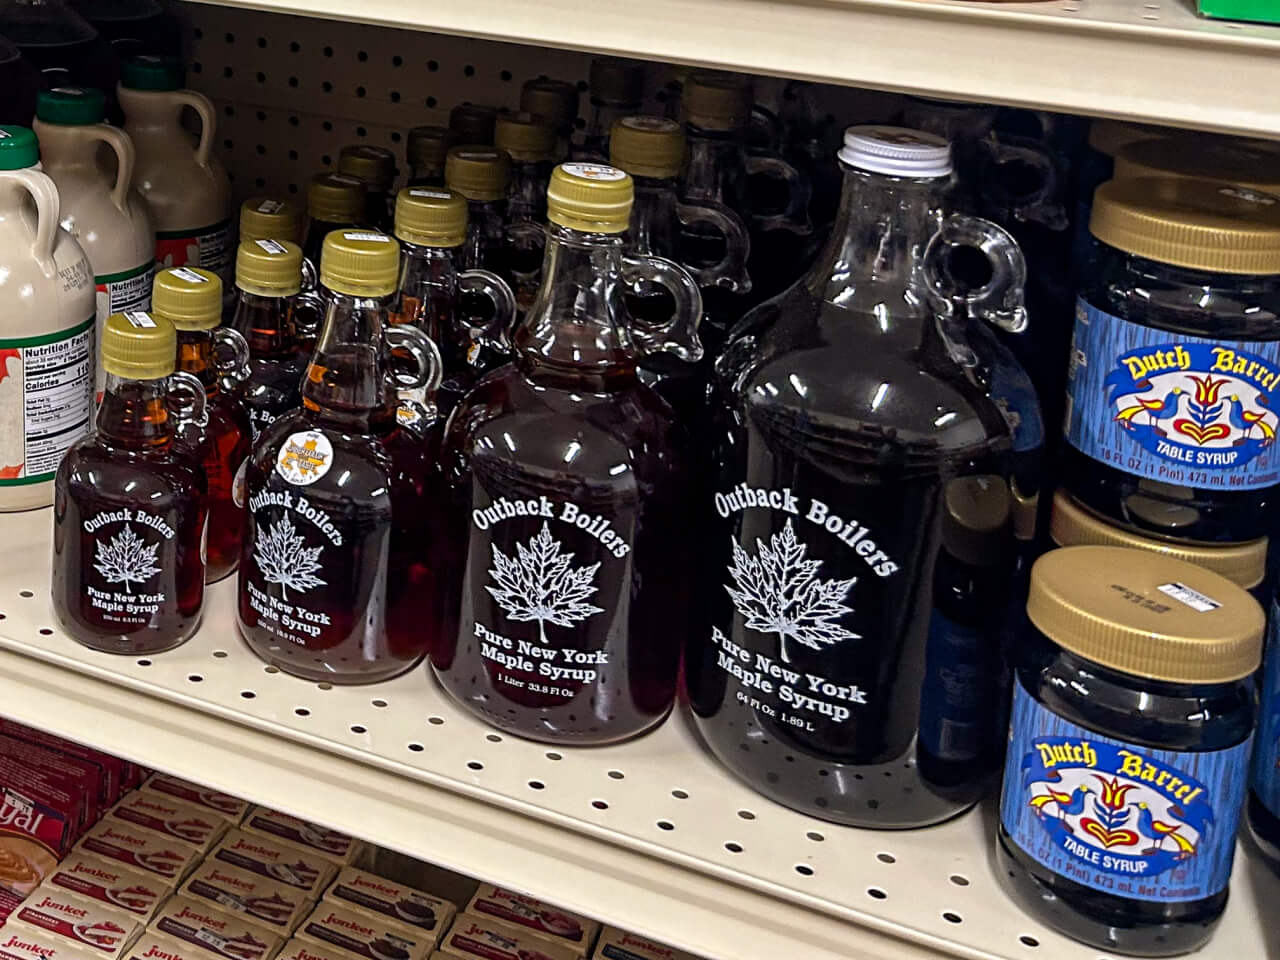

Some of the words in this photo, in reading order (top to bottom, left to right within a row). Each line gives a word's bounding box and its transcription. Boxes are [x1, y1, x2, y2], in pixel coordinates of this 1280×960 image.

[25, 342, 69, 358] Nutrition
[1122, 346, 1191, 380] Dutch
[1210, 347, 1280, 392] Barrel
[25, 378, 60, 390] Calories
[1156, 441, 1193, 462] TABLE
[1197, 451, 1238, 465] SYRUP
[84, 508, 132, 533] Outback
[135, 512, 176, 540] Boilers
[248, 490, 293, 513] Outback
[295, 497, 343, 546] Boilers
[472, 496, 554, 530] Outback
[559, 502, 631, 558] Boilers
[715, 482, 799, 518] Outback
[806, 499, 900, 577] Boilers
[87, 585, 111, 601] Pure
[114, 593, 134, 603] New
[136, 592, 165, 603] York
[92, 598, 123, 613] Maple
[126, 603, 159, 614] Syrup
[247, 581, 268, 603] Pure
[270, 597, 293, 615] New
[296, 607, 331, 626] York
[250, 597, 279, 622] Maple
[281, 615, 322, 637] Syrup
[474, 622, 512, 649] Pure
[517, 640, 558, 660] New
[561, 648, 608, 664] York
[481, 643, 534, 672] Maple
[539, 662, 597, 684] Syrup
[711, 625, 751, 662] Pure
[756, 653, 800, 684] New
[806, 673, 868, 704] York
[717, 651, 773, 693] Maple
[779, 686, 850, 723] Syrup
[1035, 742, 1098, 768] Dutch
[1118, 750, 1203, 805] Barrel
[70, 862, 119, 882] junket
[1064, 838, 1099, 865] TABLE
[1103, 854, 1148, 873] SYRUP
[36, 896, 89, 917] junket
[3, 936, 56, 957] junket
